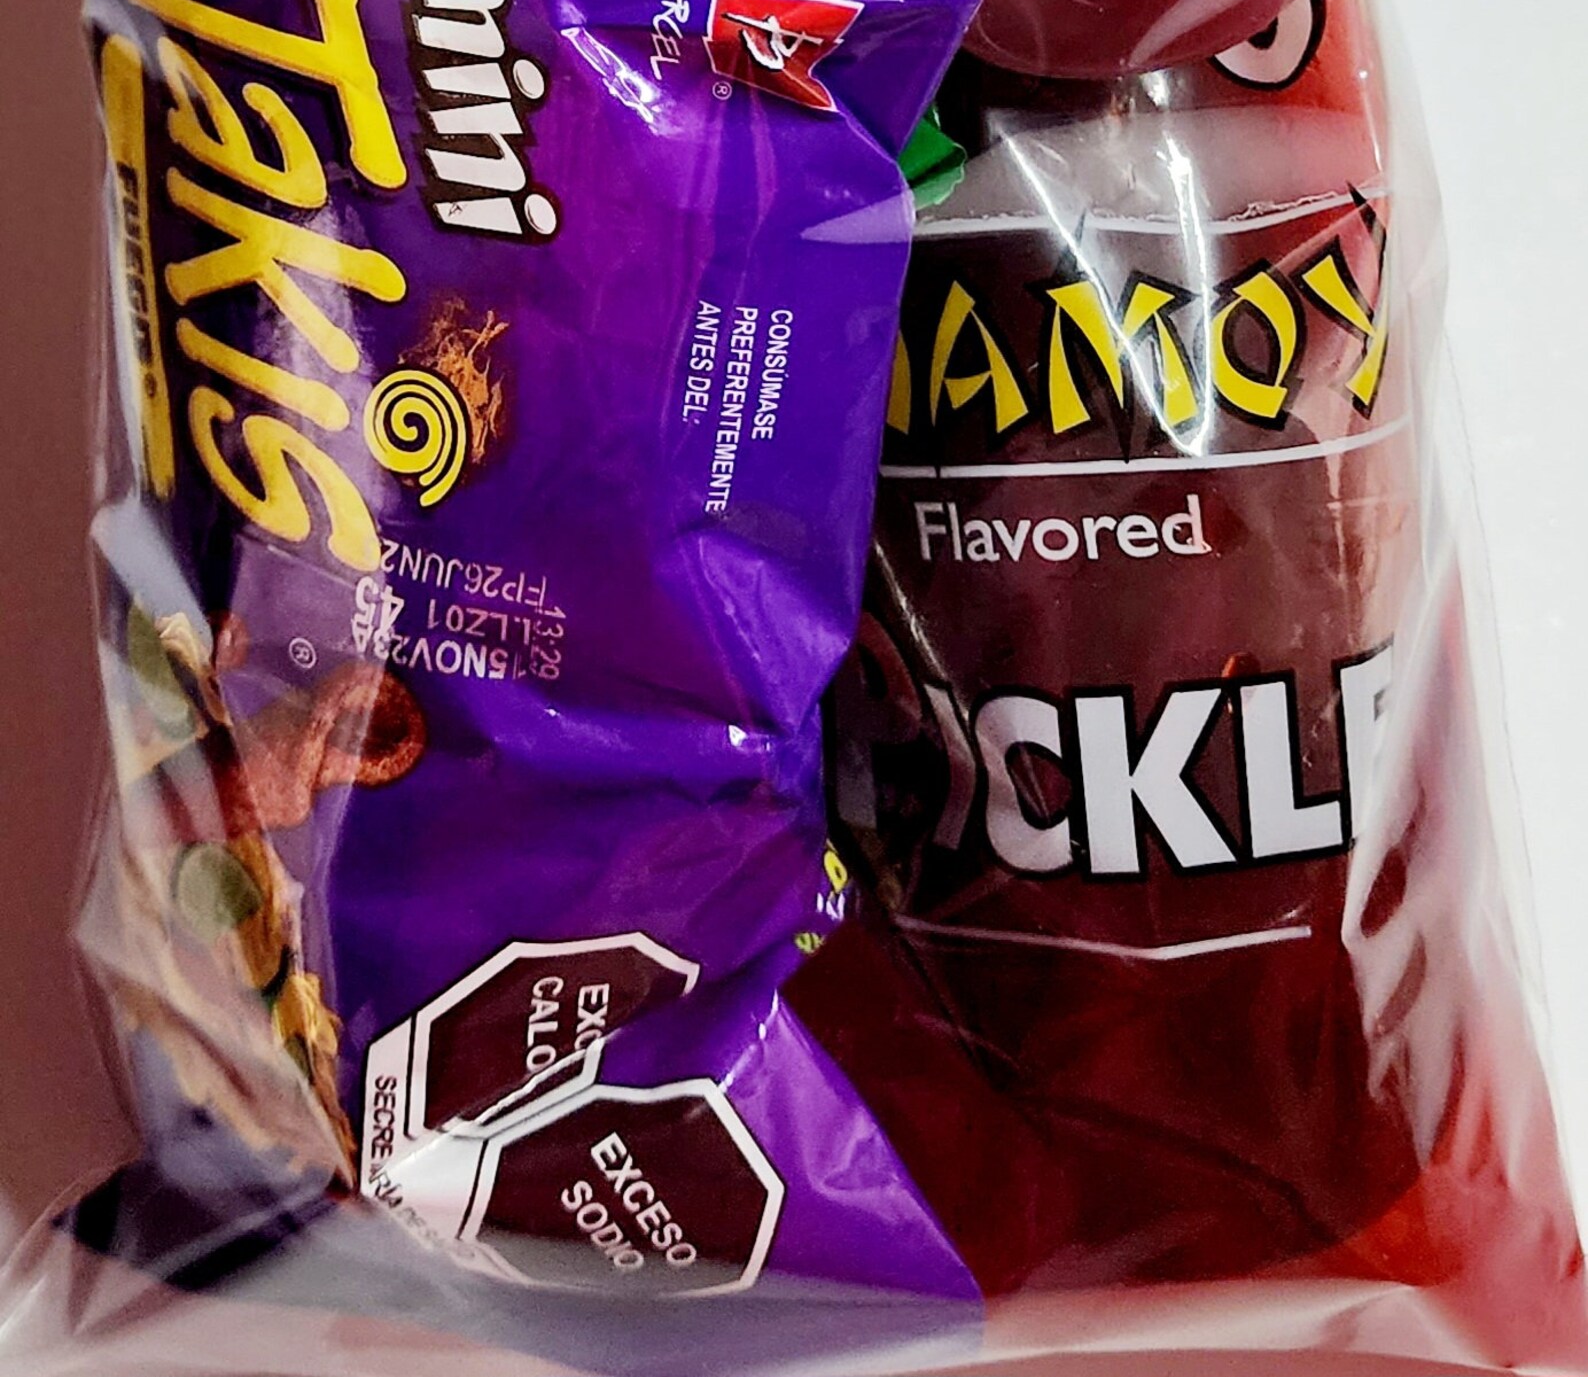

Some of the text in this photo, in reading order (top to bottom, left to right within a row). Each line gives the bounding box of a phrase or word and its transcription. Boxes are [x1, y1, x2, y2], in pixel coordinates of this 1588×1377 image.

[690, 300, 722, 372] ANTES
[751, 308, 794, 440] CONSÚMASE
[704, 306, 759, 514] PREFERENTEMENTE
[914, 494, 1213, 563] Flavored
[560, 1180, 645, 1270] SODIO
[591, 1132, 698, 1267] EXCESO
